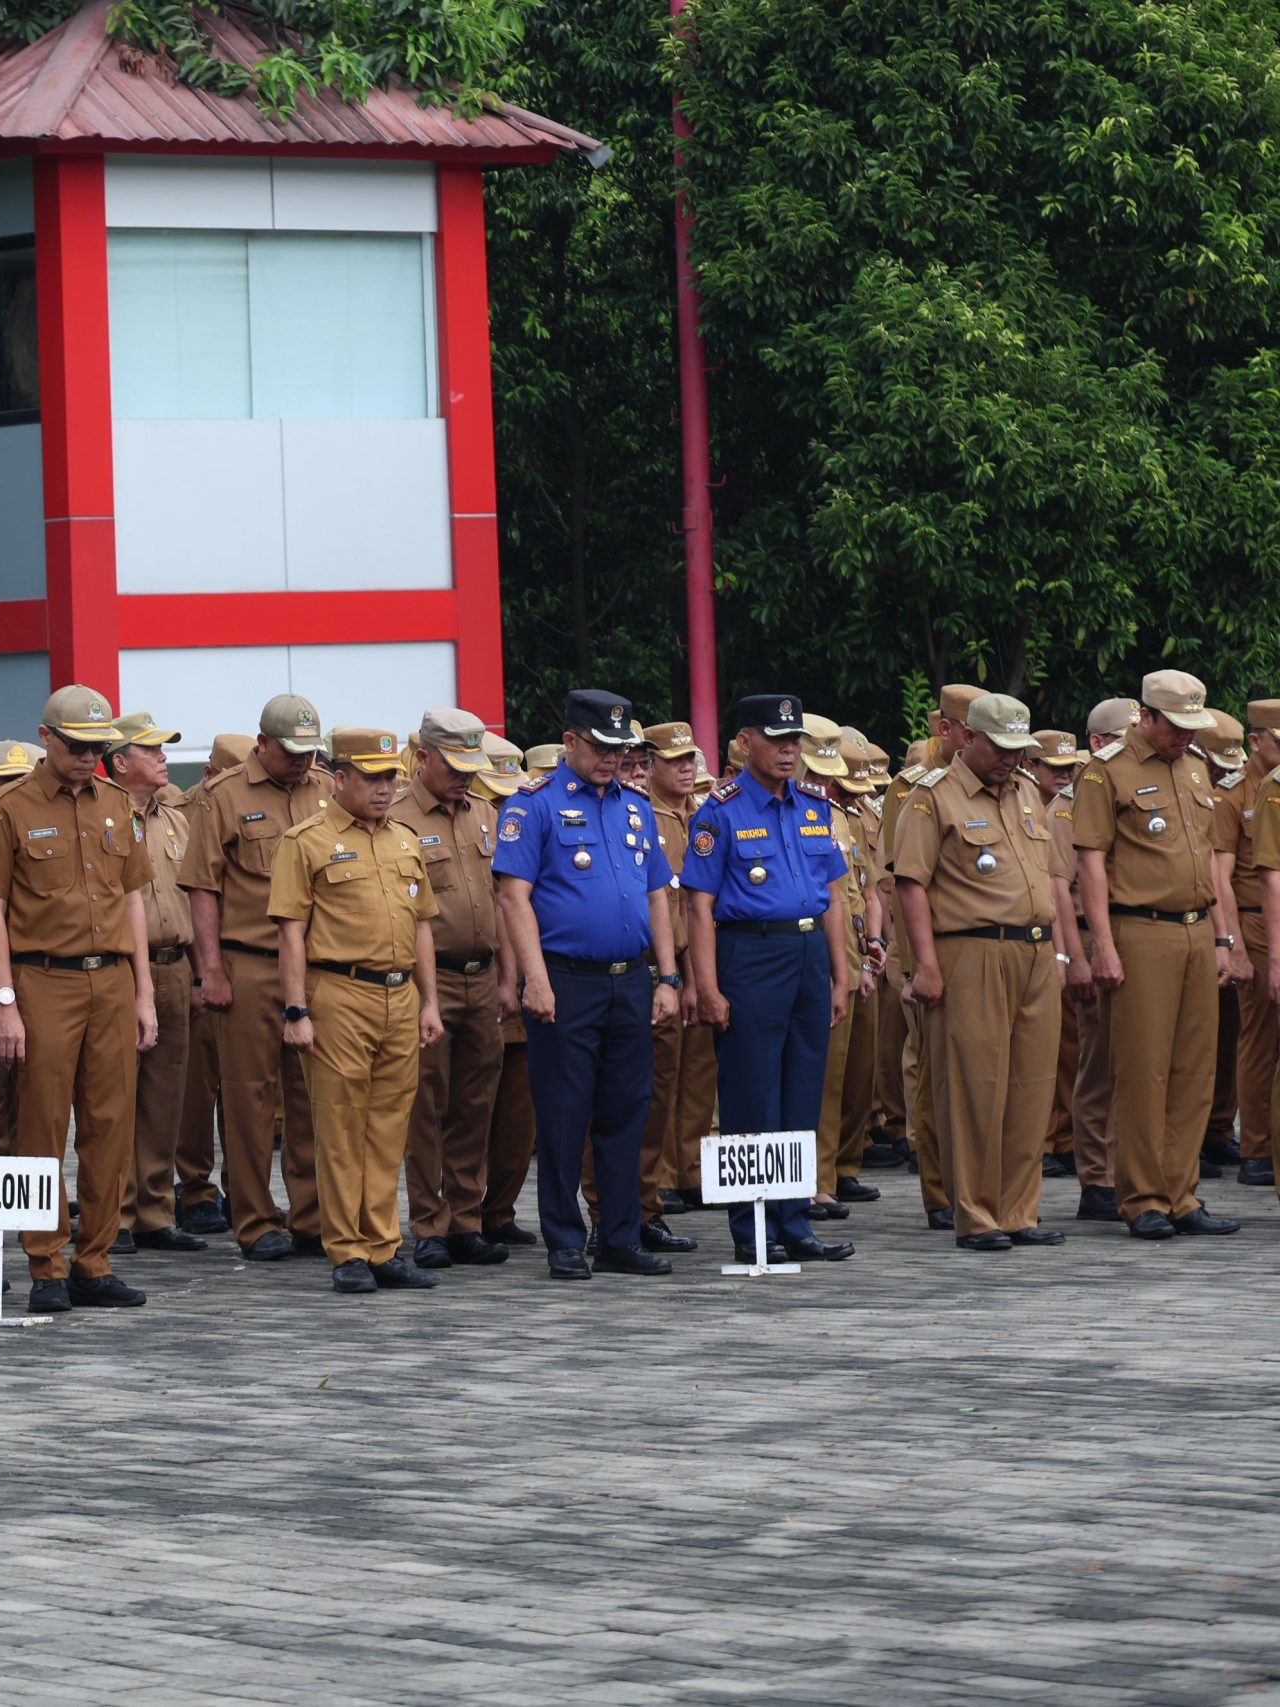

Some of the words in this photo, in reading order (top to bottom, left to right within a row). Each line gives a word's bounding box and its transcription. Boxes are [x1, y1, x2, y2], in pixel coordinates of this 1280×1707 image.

[718, 1143, 785, 1187] ESSELON
[789, 1142, 802, 1183] III
[38, 1175, 52, 1210] II
